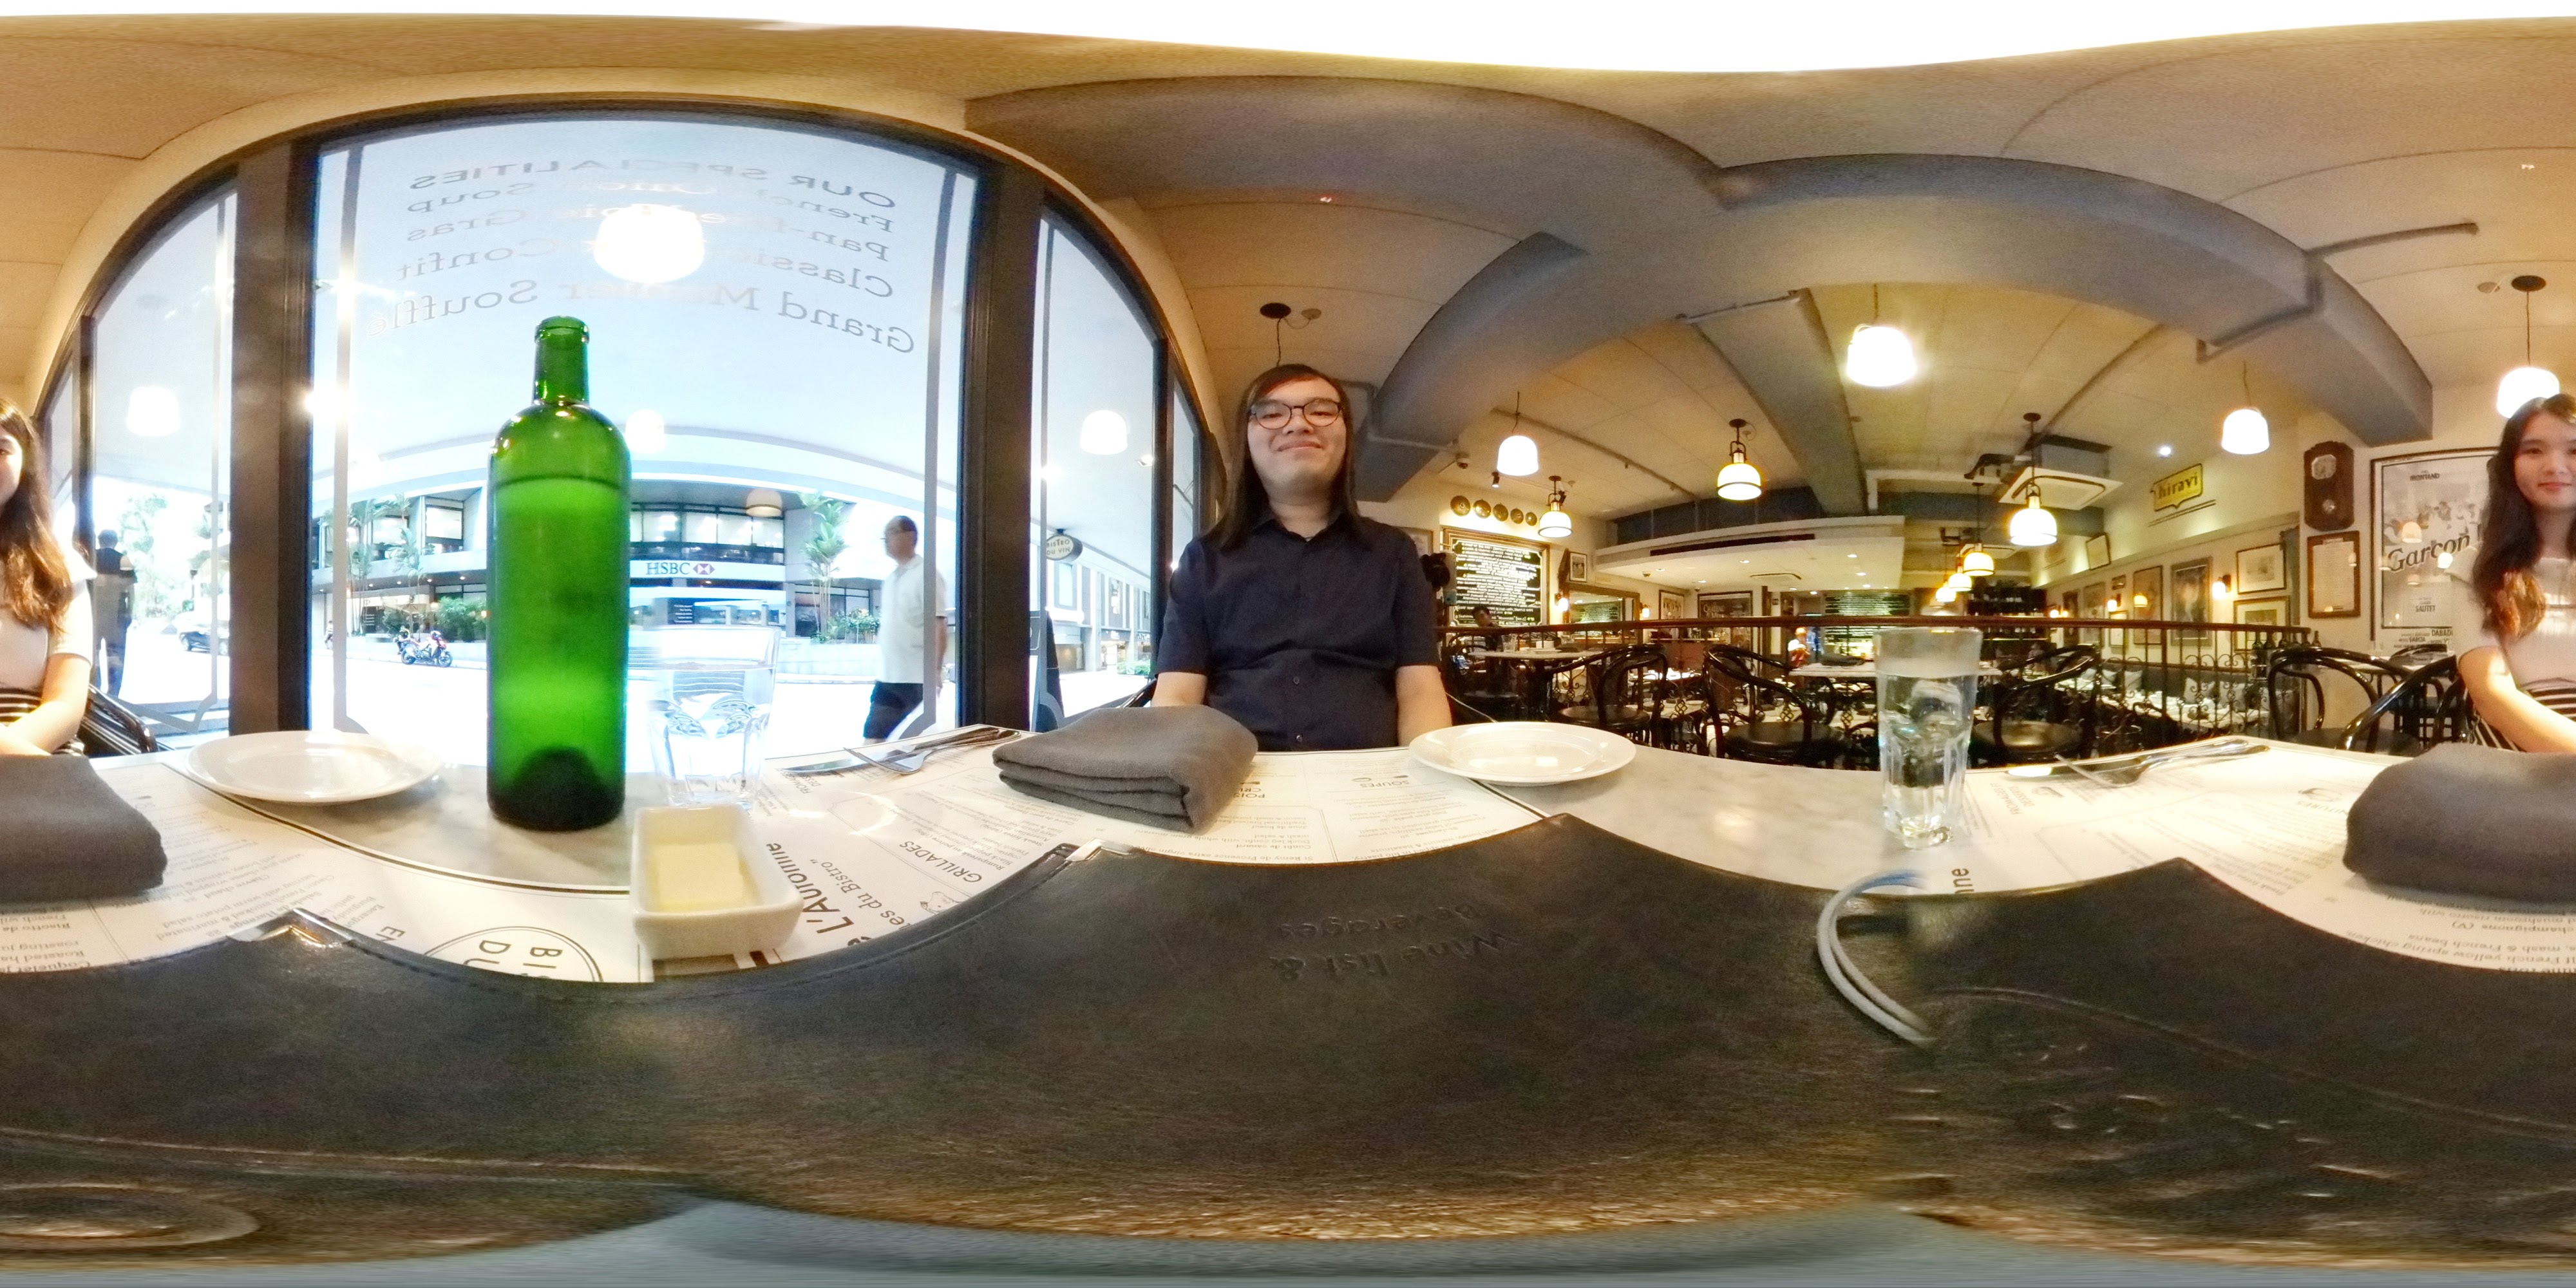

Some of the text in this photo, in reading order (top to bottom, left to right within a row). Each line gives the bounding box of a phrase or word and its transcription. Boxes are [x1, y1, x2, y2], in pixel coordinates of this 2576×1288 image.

[2410, 473, 2440, 481] MONTAND
[645, 562, 690, 575] HSBC
[1359, 779, 1410, 788] SOUPES
[900, 840, 983, 883] GRILLADES
[2452, 951, 2502, 962] yellow
